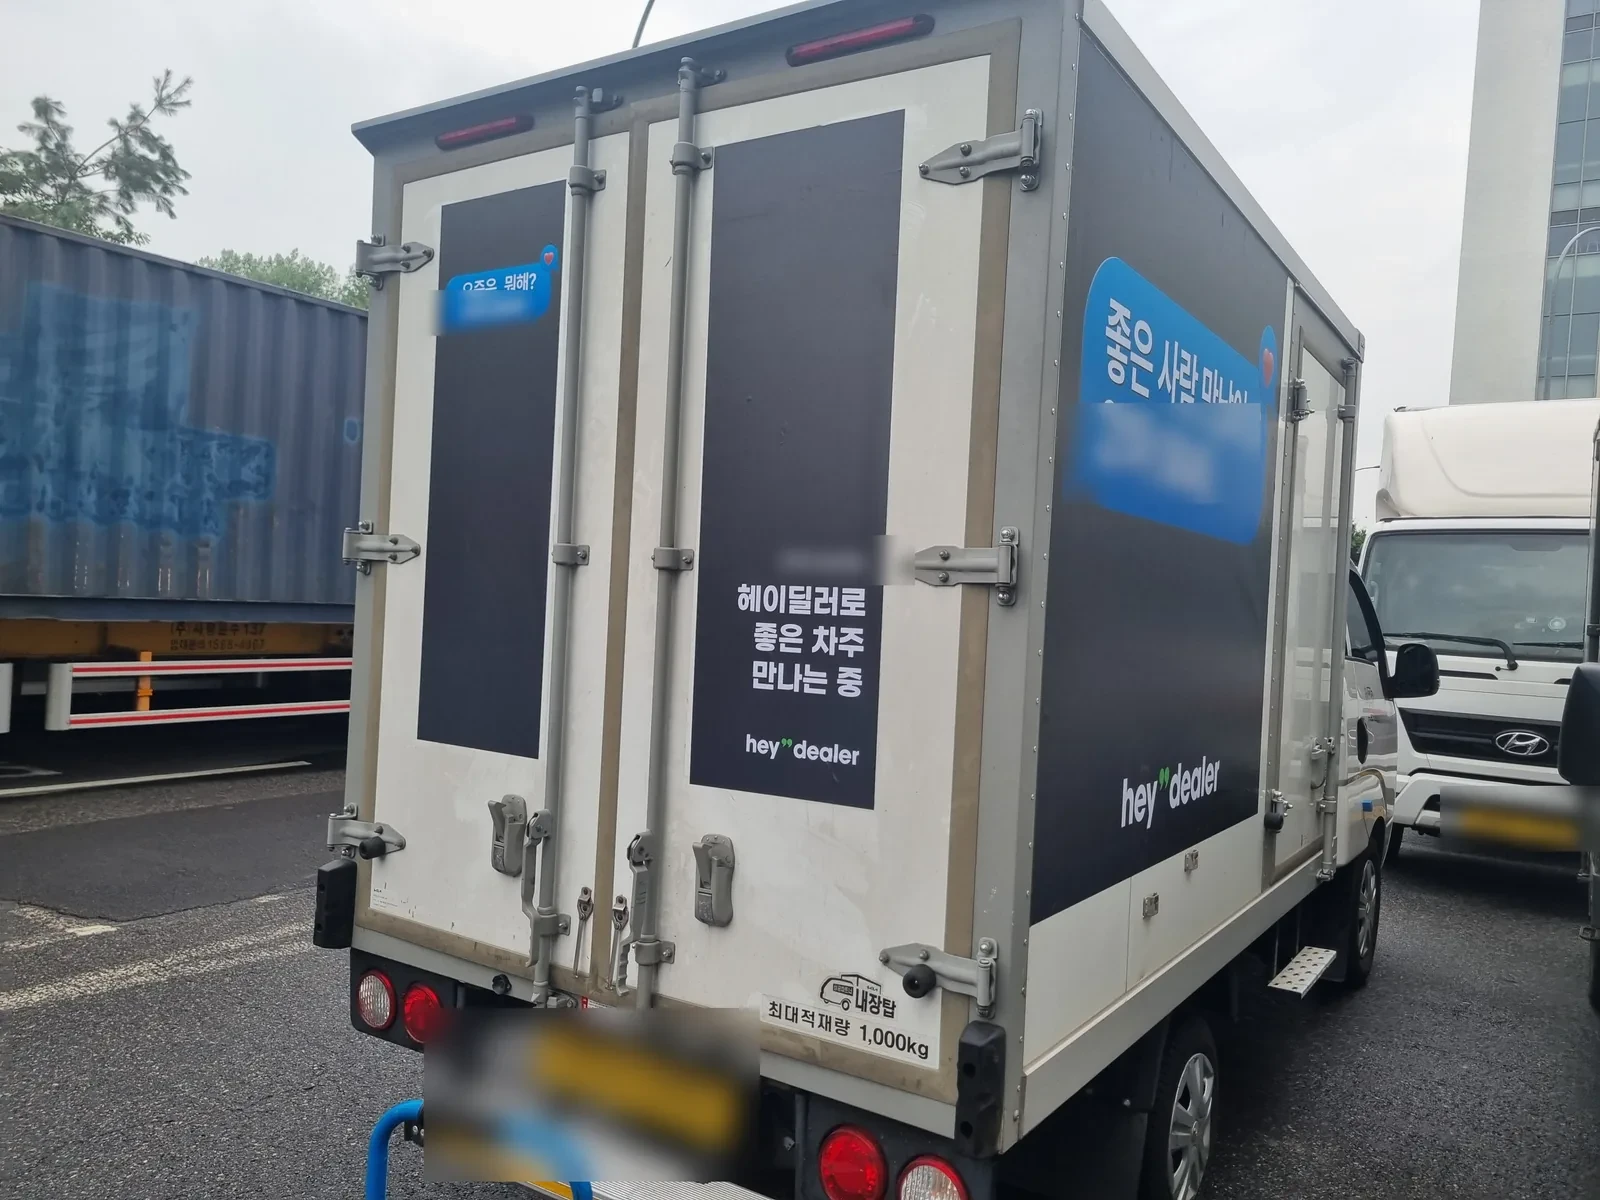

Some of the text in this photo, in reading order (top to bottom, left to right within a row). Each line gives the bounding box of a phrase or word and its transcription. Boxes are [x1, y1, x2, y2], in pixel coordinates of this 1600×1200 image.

[1105, 298, 1154, 399] 좋은
[737, 583, 866, 617] 헤이딜러로
[754, 622, 865, 658] 좋은 차주
[752, 660, 863, 698] 만나는 중
[855, 988, 897, 1019] 내장탑
[768, 1001, 929, 1060] 최대적재량 1,000kg
